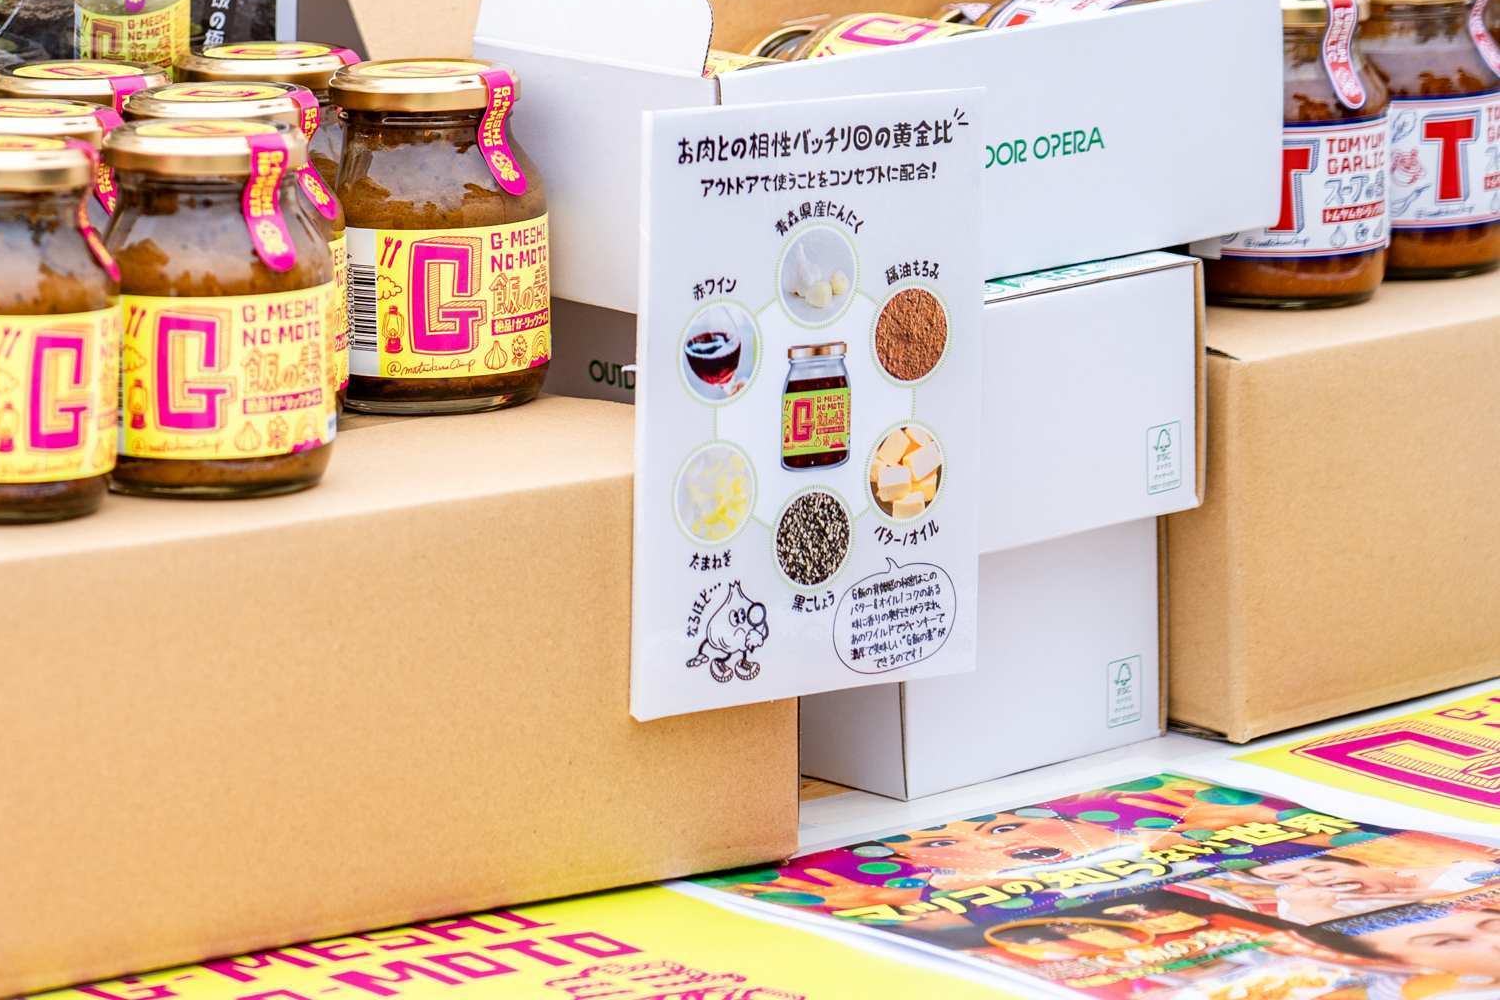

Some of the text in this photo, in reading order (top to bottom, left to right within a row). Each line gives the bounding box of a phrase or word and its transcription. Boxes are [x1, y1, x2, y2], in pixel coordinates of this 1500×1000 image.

[1034, 126, 1106, 160] OPERA
[1326, 131, 1385, 154] TOMYUM
[1422, 109, 1481, 204] T
[700, 161, 937, 198] アウトドアで使うことをコンセプトに配合!
[1327, 151, 1384, 175] GARLIC
[774, 200, 865, 237] 青森県産にんにく
[490, 223, 546, 250] G-MESHI
[490, 245, 547, 273] NO-MOTO
[407, 235, 487, 356] G
[692, 276, 738, 301] 赤ワイン
[154, 305, 237, 435] G
[26, 323, 96, 453] G
[792, 397, 816, 443] G
[688, 550, 732, 572] たまねぎ
[791, 590, 836, 613] 黒こしょう
[832, 808, 1361, 923] マツコの知らない世界
